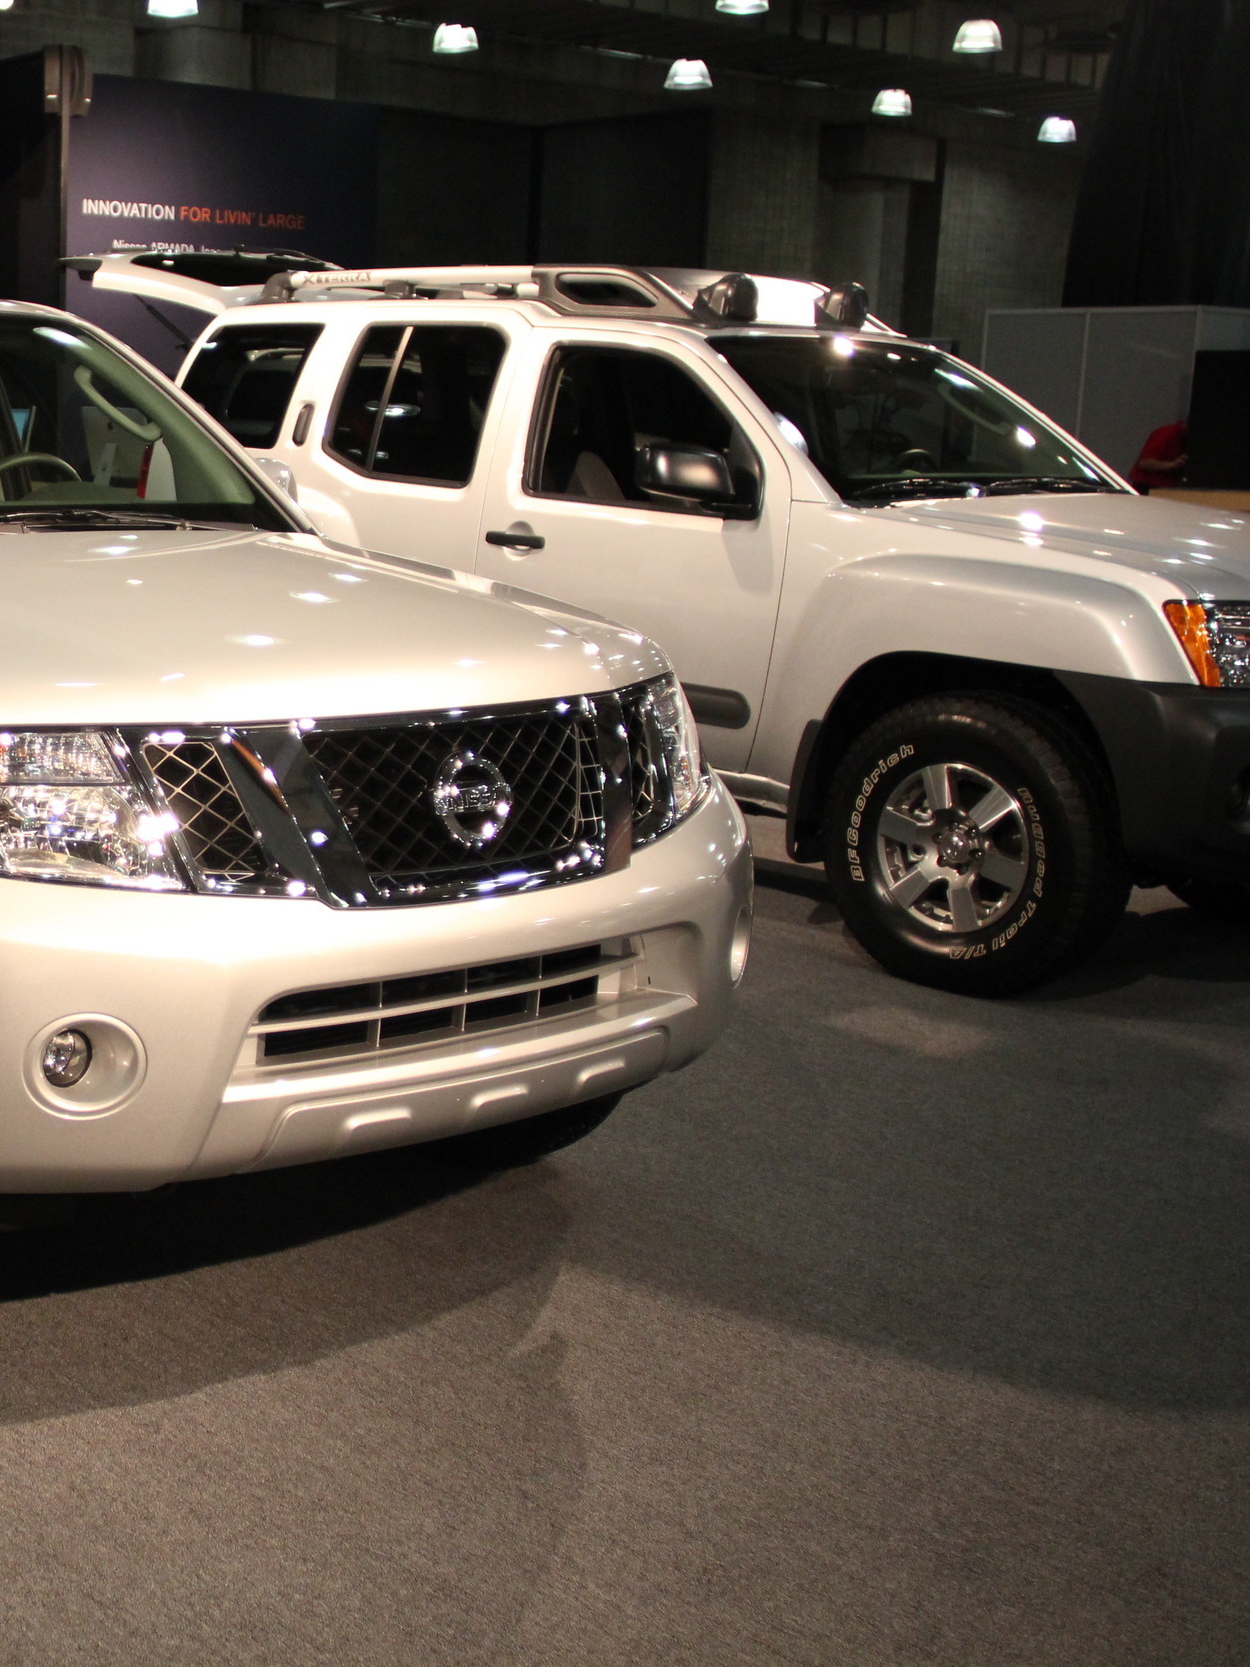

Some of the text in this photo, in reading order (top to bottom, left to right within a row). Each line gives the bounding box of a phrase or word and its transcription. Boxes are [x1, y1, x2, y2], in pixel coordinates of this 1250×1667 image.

[81, 198, 305, 229] INNOVATION FOR LIVIN' LARGE
[302, 271, 371, 285] XTERRA
[847, 744, 914, 882] BFGoodrich
[992, 900, 1037, 951] Trail
[949, 945, 988, 960] T/A
